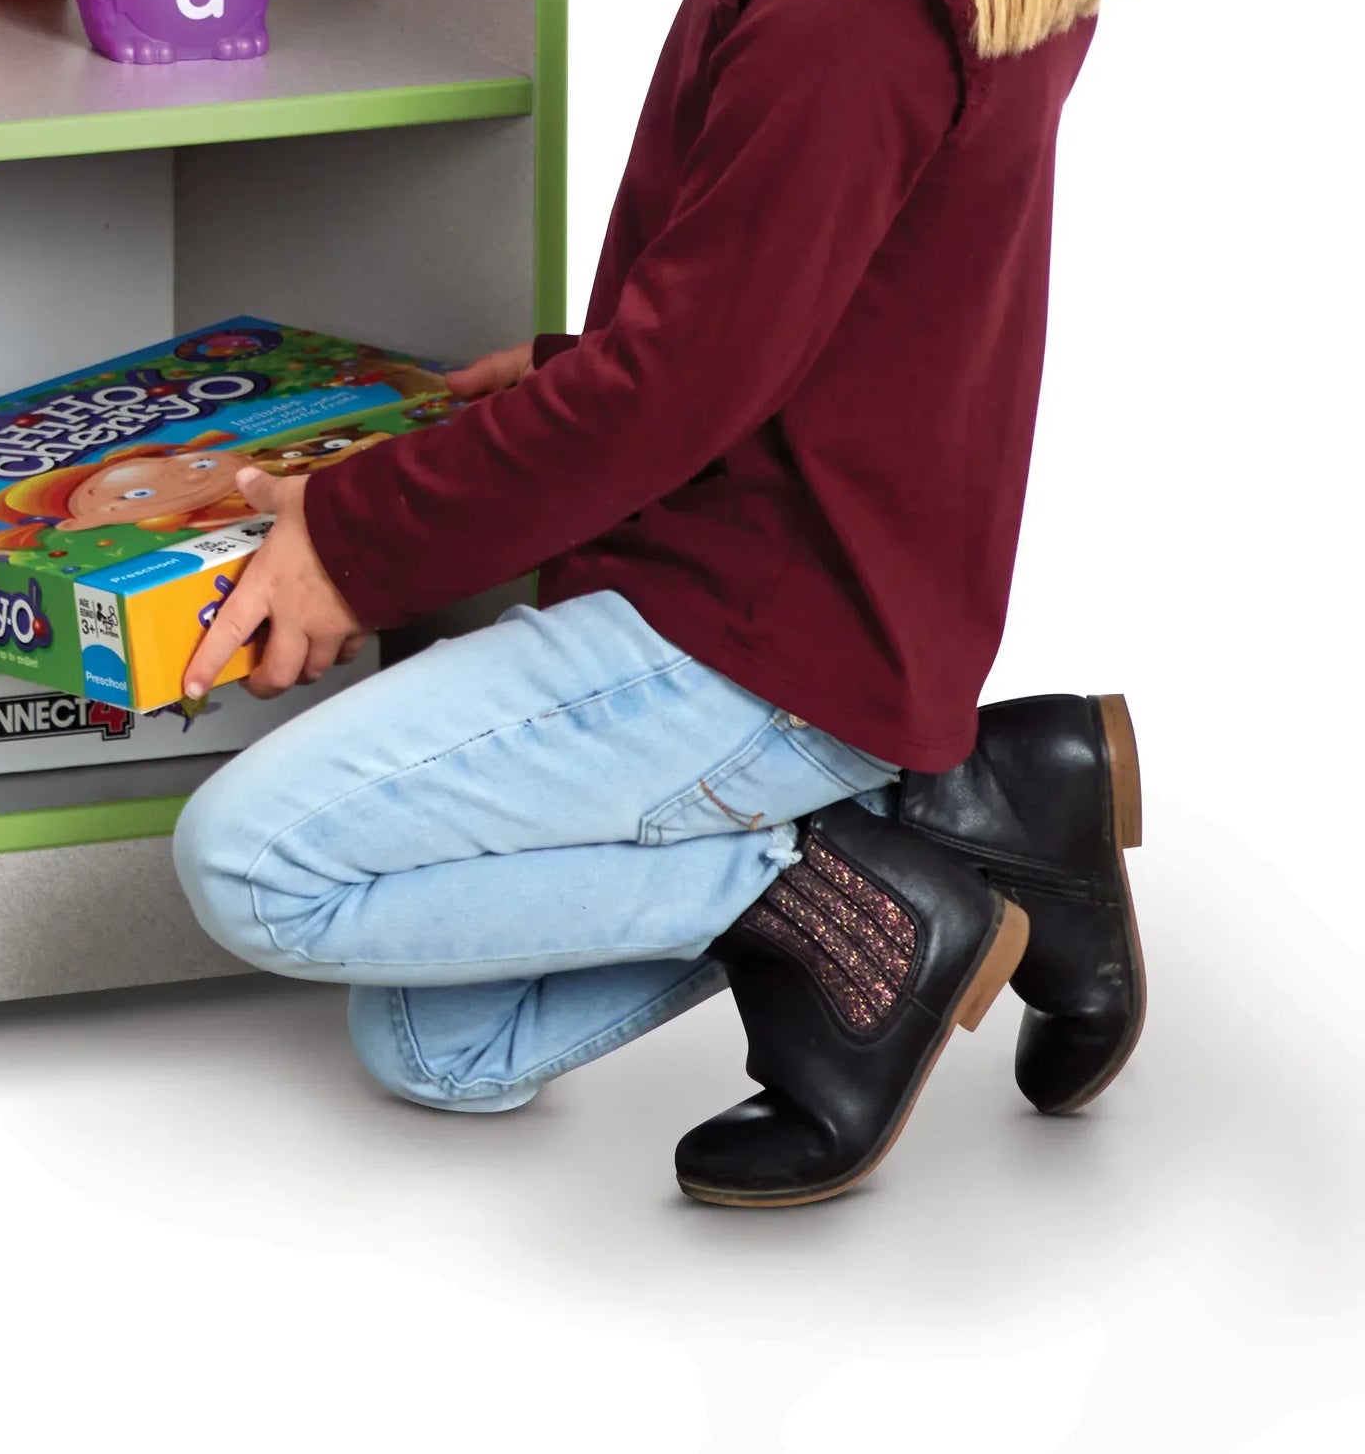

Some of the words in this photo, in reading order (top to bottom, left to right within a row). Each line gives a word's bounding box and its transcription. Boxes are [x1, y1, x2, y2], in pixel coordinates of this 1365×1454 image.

[110, 558, 180, 583] Preschool
[79, 598, 90, 609] AGE
[81, 619, 96, 636] 3+
[0, 650, 7, 660] up
[85, 670, 128, 692] Preschool
